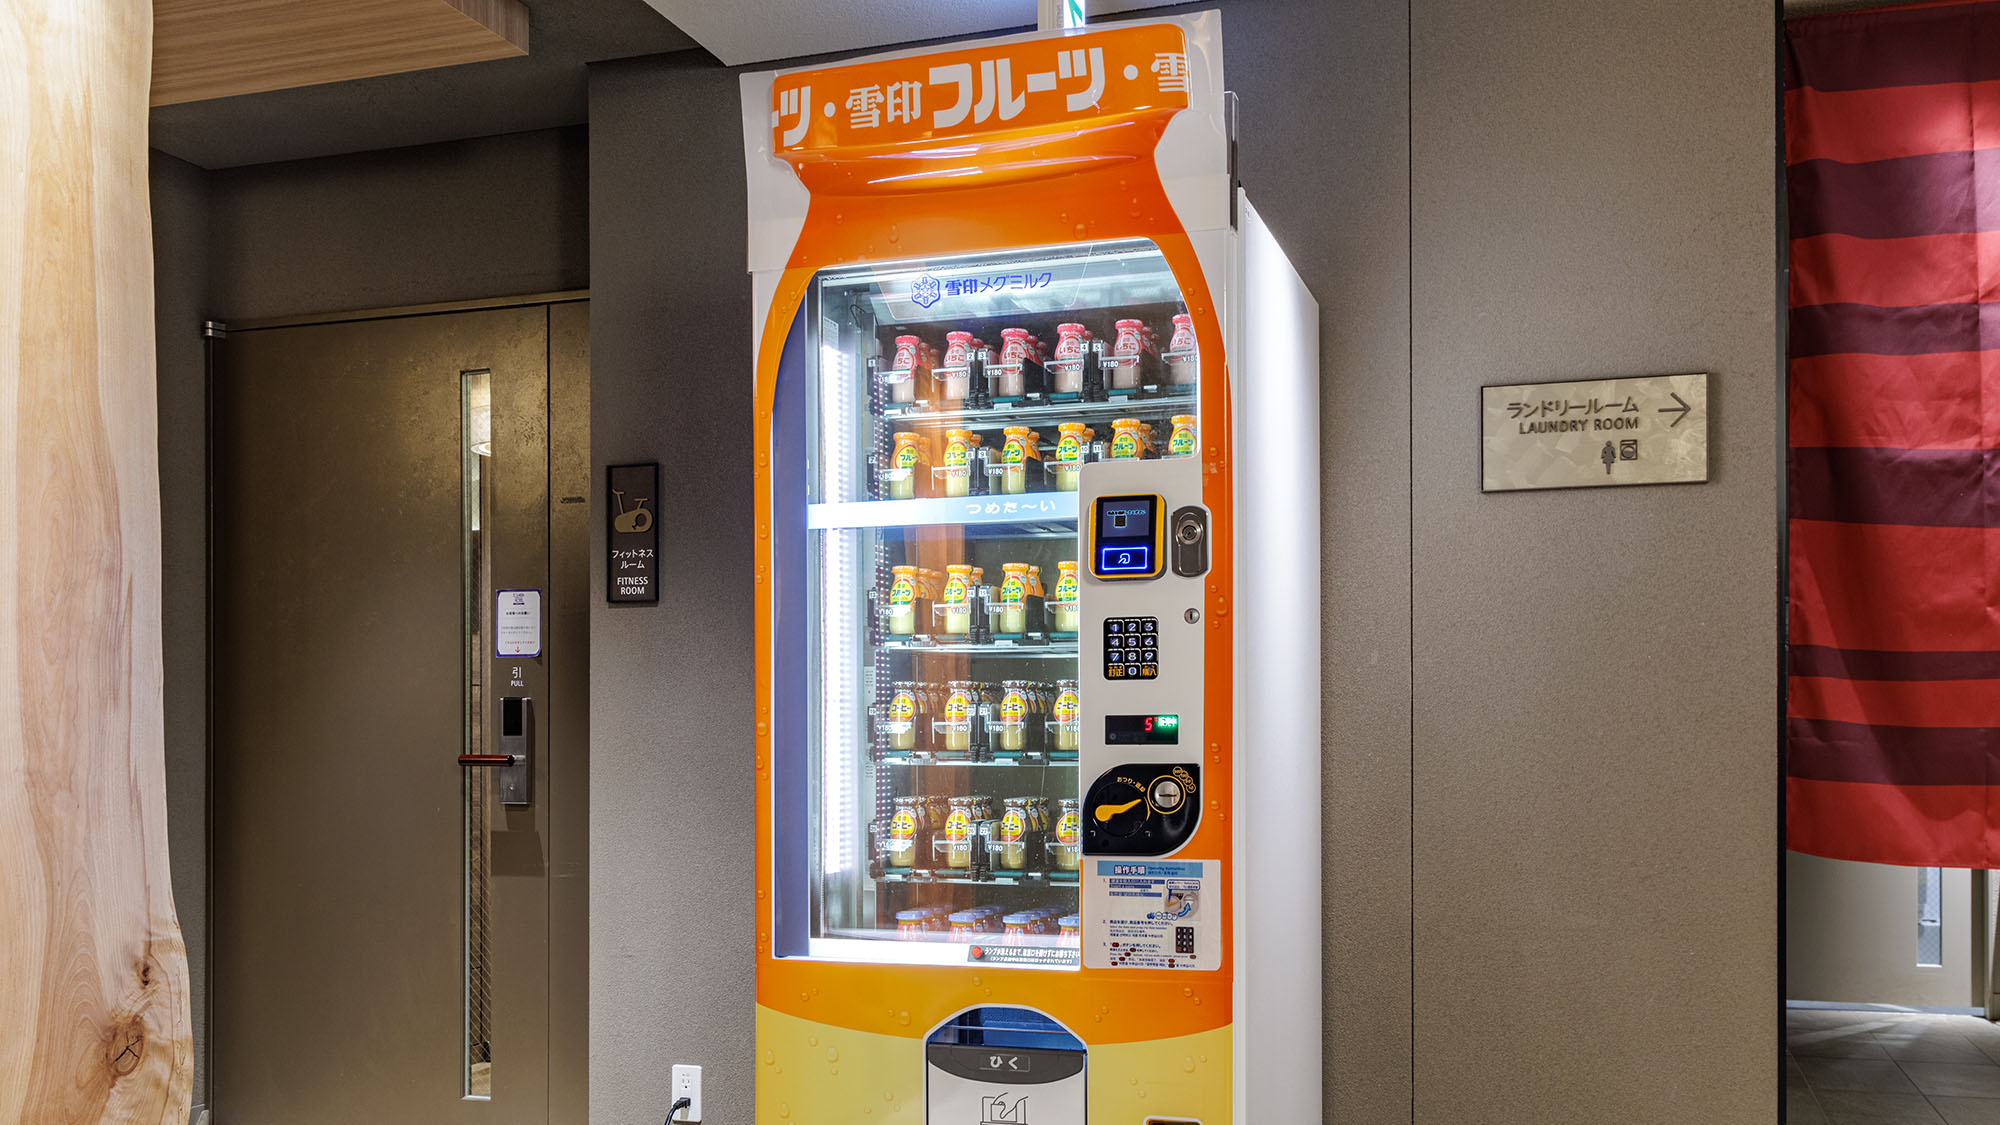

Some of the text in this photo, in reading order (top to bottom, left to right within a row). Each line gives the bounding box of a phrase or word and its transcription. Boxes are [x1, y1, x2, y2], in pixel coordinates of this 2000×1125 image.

[944, 272, 1052, 297] 雪印メグミルク
[1103, 360, 1119, 368] ¥180
[1506, 396, 1639, 419] ランドリールーム
[1519, 416, 1639, 434] LAUNDRY ROOM
[1113, 442, 1134, 451] フルーツ
[612, 549, 654, 559] フィットネス
[620, 560, 645, 569] ルーム
[617, 576, 648, 585] FITNESS
[620, 586, 645, 595] ROOM
[1112, 622, 1154, 632] 1 2 3
[1111, 637, 1154, 647] 4 5 6
[1111, 652, 1154, 662] 7 8 9
[512, 666, 522, 679] 引
[1128, 666, 1137, 676] 0
[987, 844, 1004, 852] ¥180
[989, 1056, 1018, 1070] ひく
